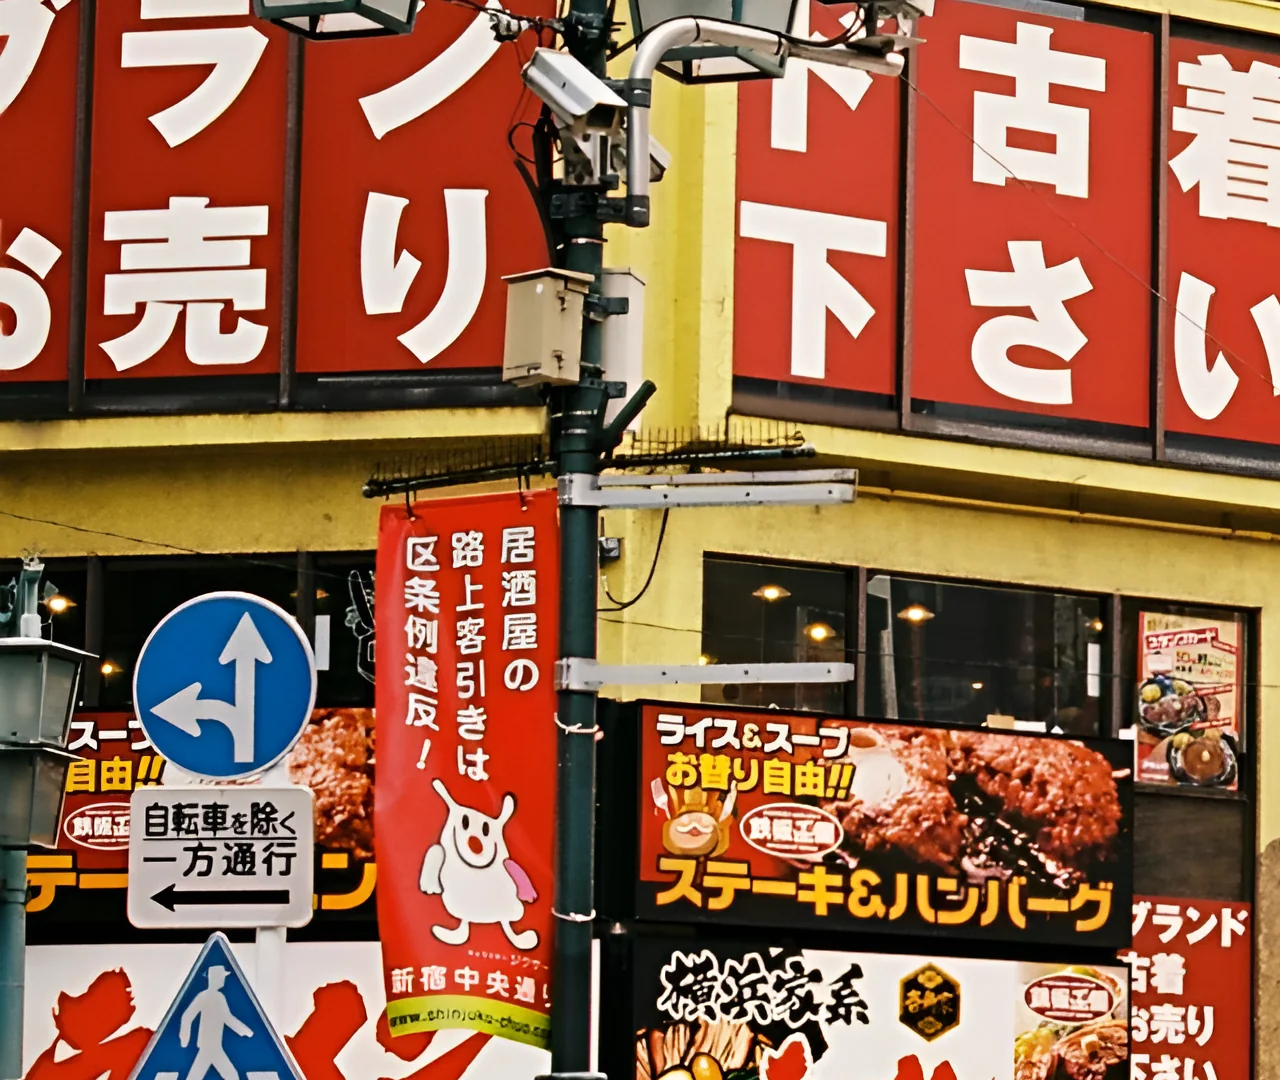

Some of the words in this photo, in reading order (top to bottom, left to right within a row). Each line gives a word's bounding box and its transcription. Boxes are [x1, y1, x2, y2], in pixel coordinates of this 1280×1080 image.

[0, 0, 502, 147] ラン
[500, 525, 540, 692] 居酒屋の
[403, 535, 441, 771] 区条例違反!
[451, 530, 491, 782] 路上客引きは
[656, 713, 851, 759] ライス&スープ
[66, 757, 166, 793] 自由!!
[666, 750, 854, 801] お替り自由!!
[143, 802, 297, 837] 自転車を除く
[142, 841, 298, 877] 一方通行
[656, 855, 1114, 933] ステーキ&ハンバーグ
